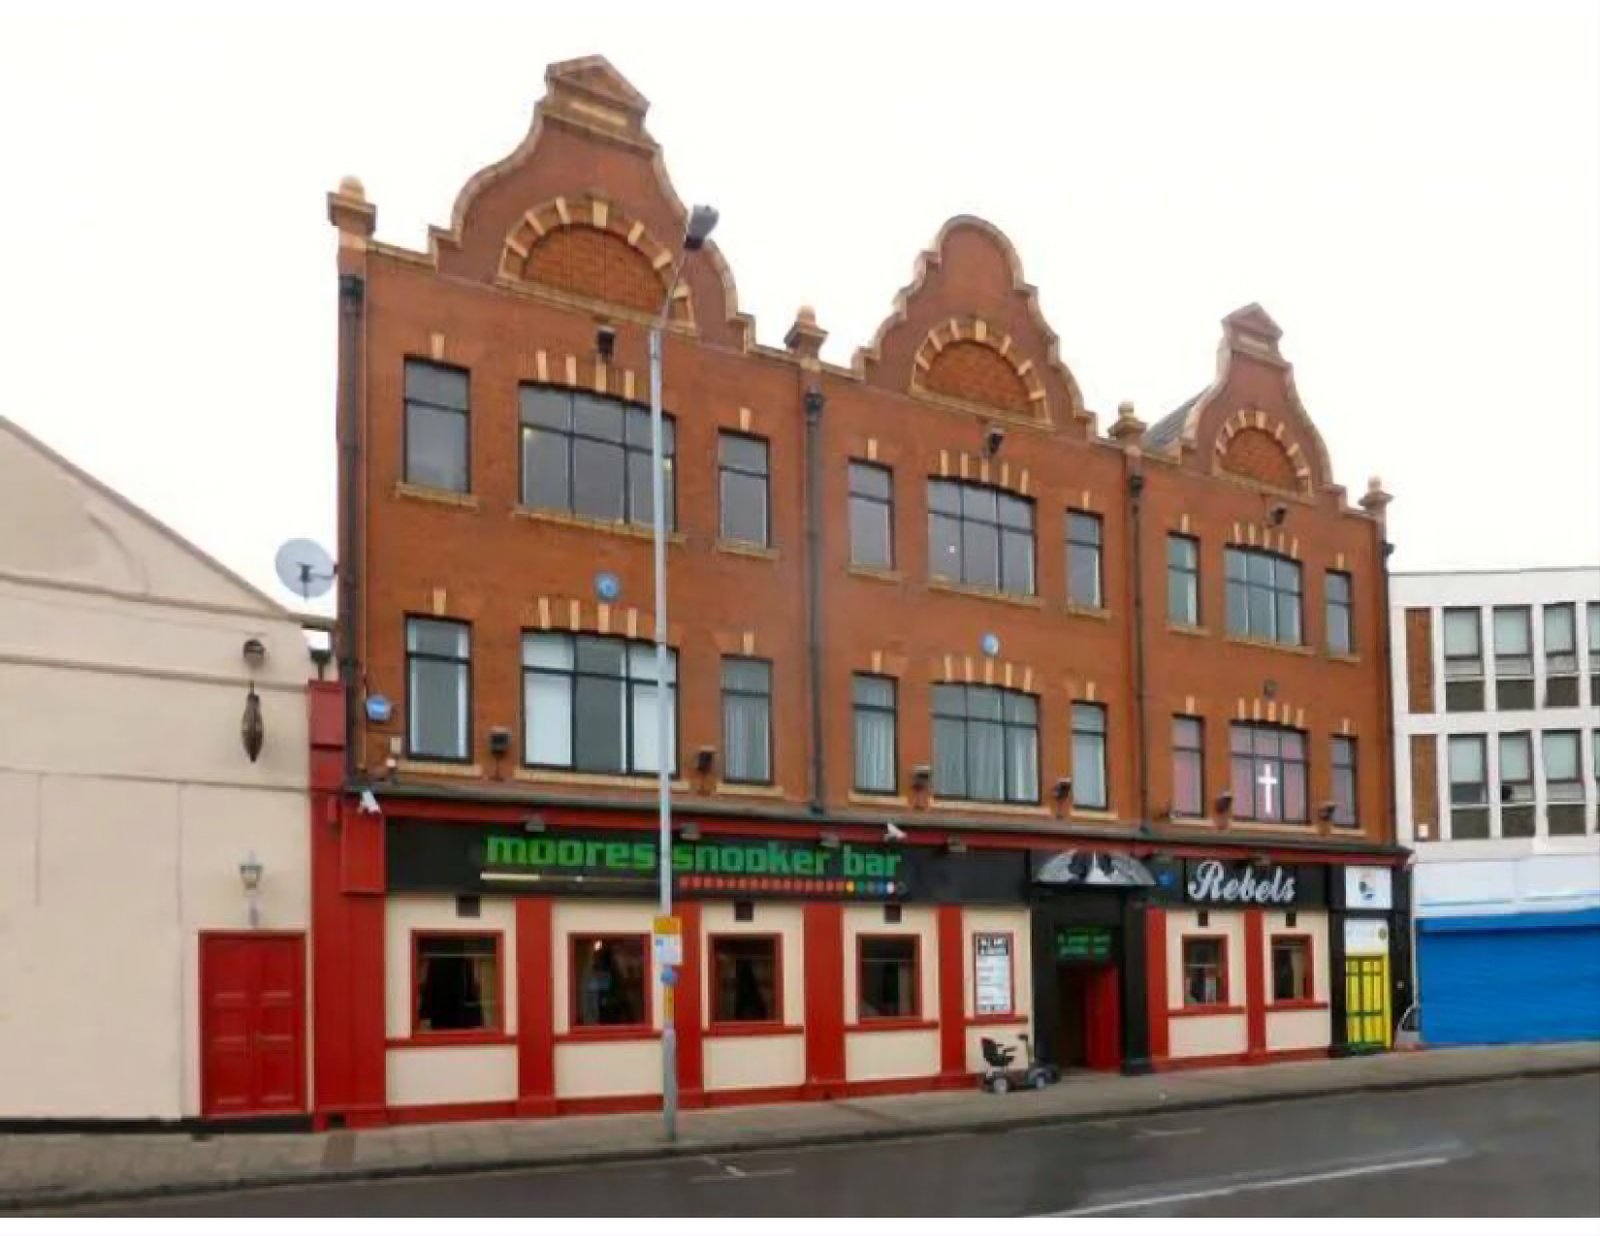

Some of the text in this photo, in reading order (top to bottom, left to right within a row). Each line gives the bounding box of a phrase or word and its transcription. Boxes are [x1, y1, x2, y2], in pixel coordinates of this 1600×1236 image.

[486, 836, 902, 877] moores snooker bar
[1187, 859, 1296, 904] Rebels
